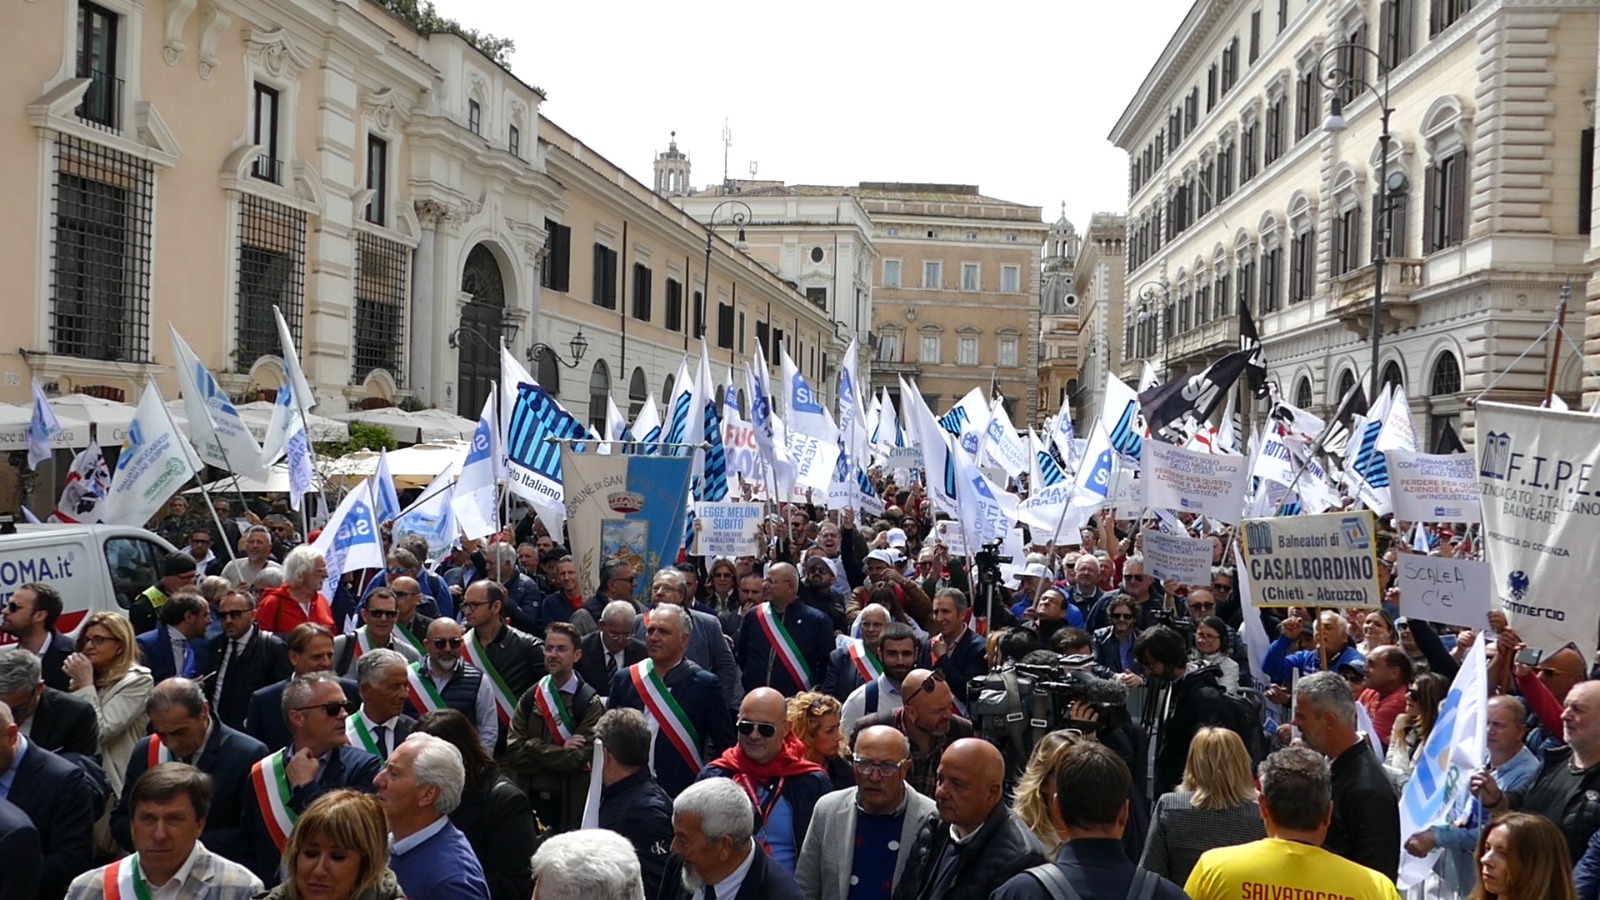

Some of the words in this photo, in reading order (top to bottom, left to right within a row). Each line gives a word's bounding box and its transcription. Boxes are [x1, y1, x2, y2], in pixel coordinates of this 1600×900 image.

[1191, 461, 1214, 470] NELLE
[1199, 457, 1220, 465] SOLO
[1455, 458, 1475, 466] SOLO
[1170, 463, 1191, 472] DELLO
[1193, 468, 1215, 476] STATO
[1421, 469, 1446, 477] DELLO
[1507, 453, 1600, 498] F.I.P.E.
[521, 473, 561, 501] Italiano
[1202, 478, 1232, 489] QUESTO
[567, 483, 595, 519] COMUNE
[603, 475, 623, 488] SAN
[1478, 482, 1532, 504] SINDACATO
[1538, 494, 1600, 516] ITALIANO
[699, 506, 725, 518] LEGGE
[727, 506, 760, 518] MELONI
[1503, 501, 1558, 525] BALNEARI
[713, 518, 744, 530] SUBITO
[1278, 533, 1328, 548] Balneatori
[1329, 532, 1340, 547] di
[1522, 539, 1531, 549] DI
[1250, 555, 1374, 581] CASALBORDINO
[1404, 562, 1466, 591] SCALEA
[1262, 586, 1304, 603] (Chieti
[1316, 587, 1368, 604] Abruzzo)
[1242, 882, 1356, 900] SALVATA
